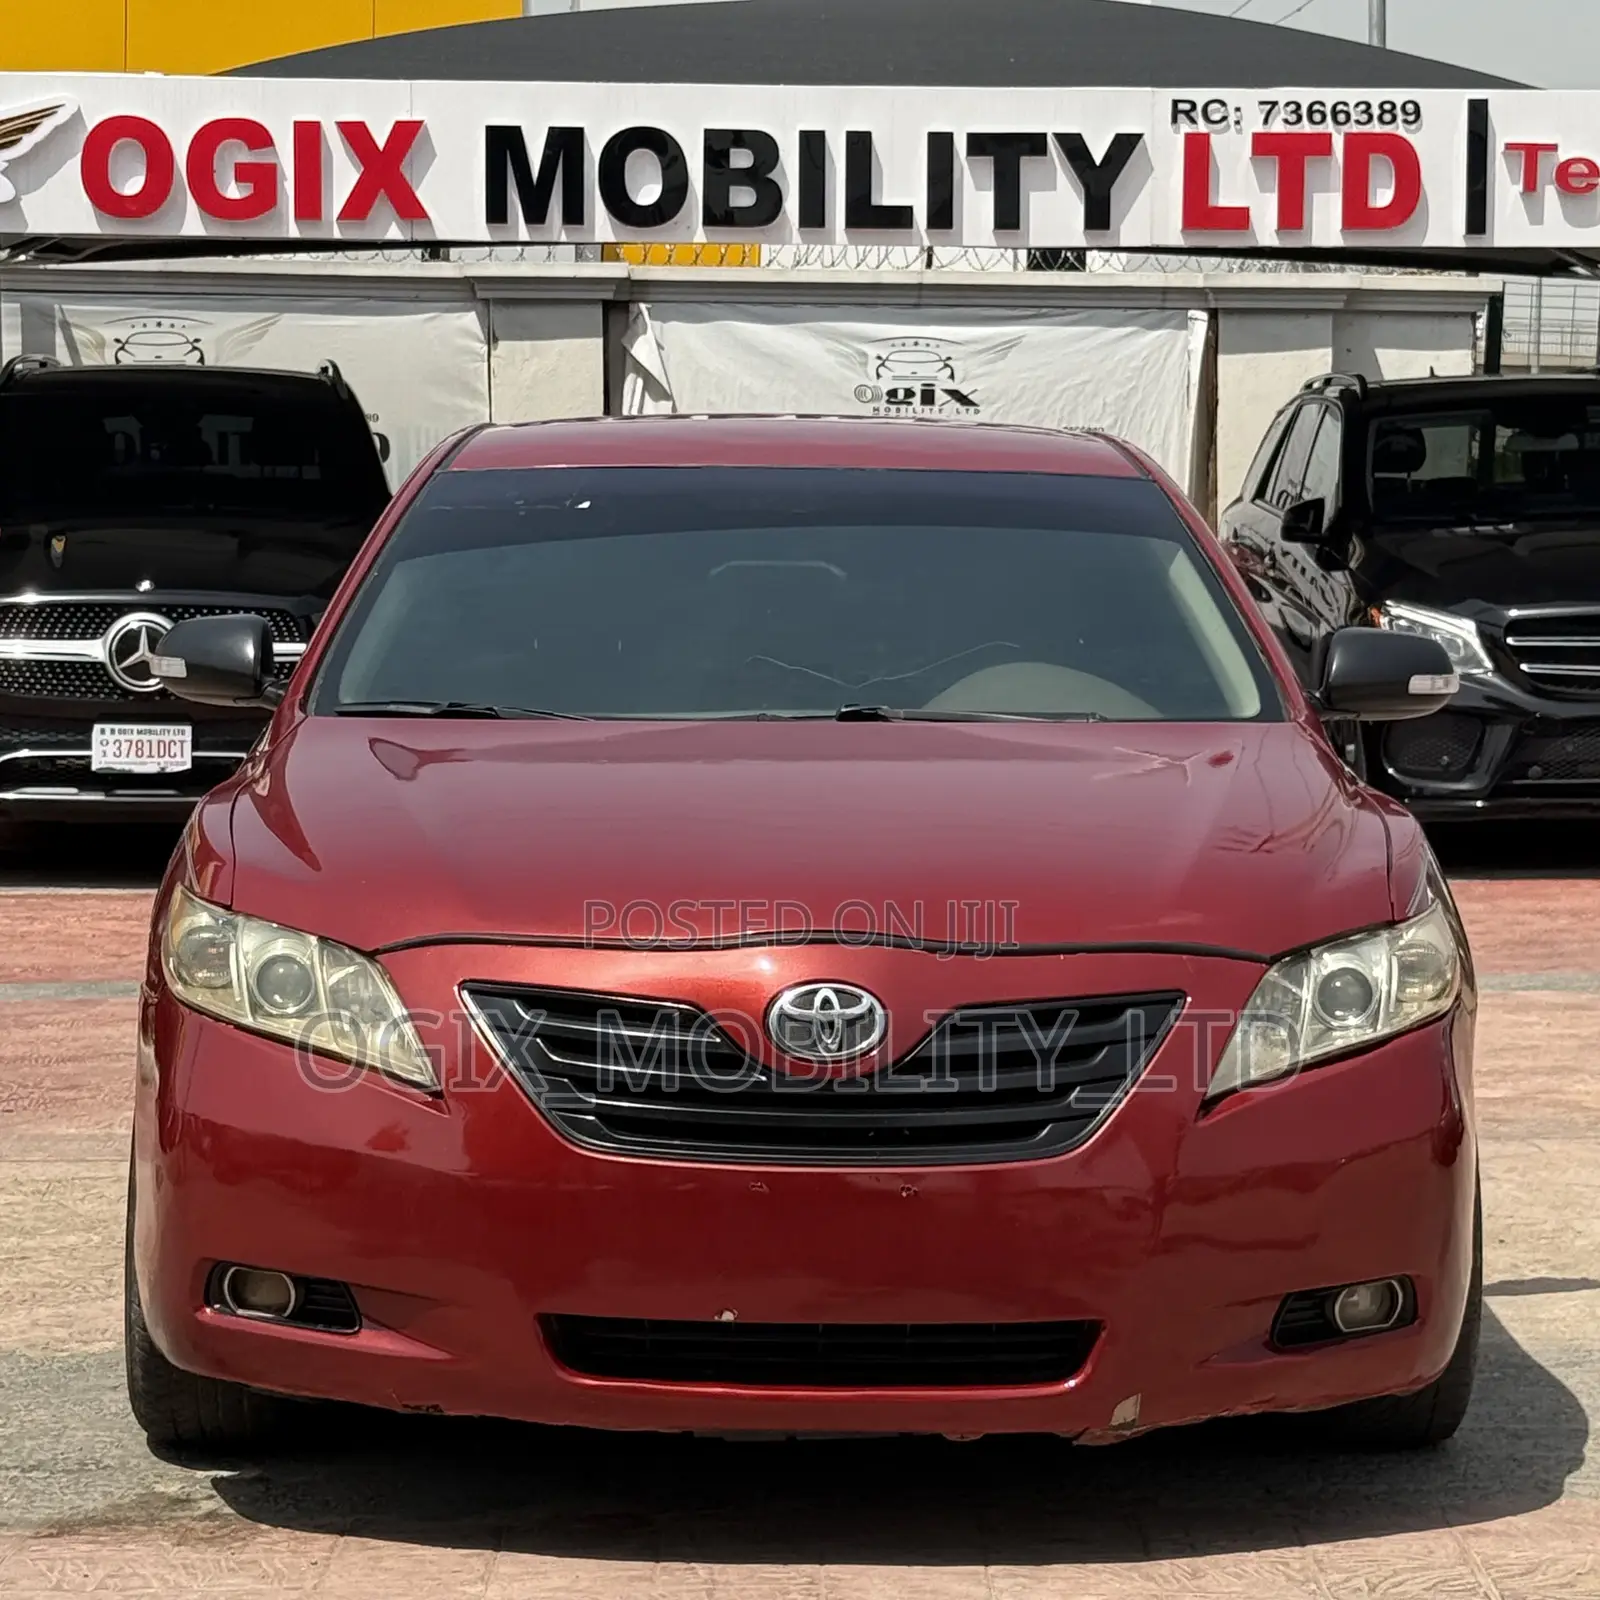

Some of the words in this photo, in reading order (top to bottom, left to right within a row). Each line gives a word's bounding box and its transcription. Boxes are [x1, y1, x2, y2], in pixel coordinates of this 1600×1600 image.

[1170, 98, 1242, 125] RC:
[1260, 99, 1422, 127] 7366389
[81, 114, 430, 221] OGIX
[485, 124, 1145, 231] MOBILITY
[1181, 131, 1422, 232] LTD
[872, 406, 944, 415] MOBILITY
[955, 407, 981, 416] LTD
[112, 739, 188, 759] 3781DCT
